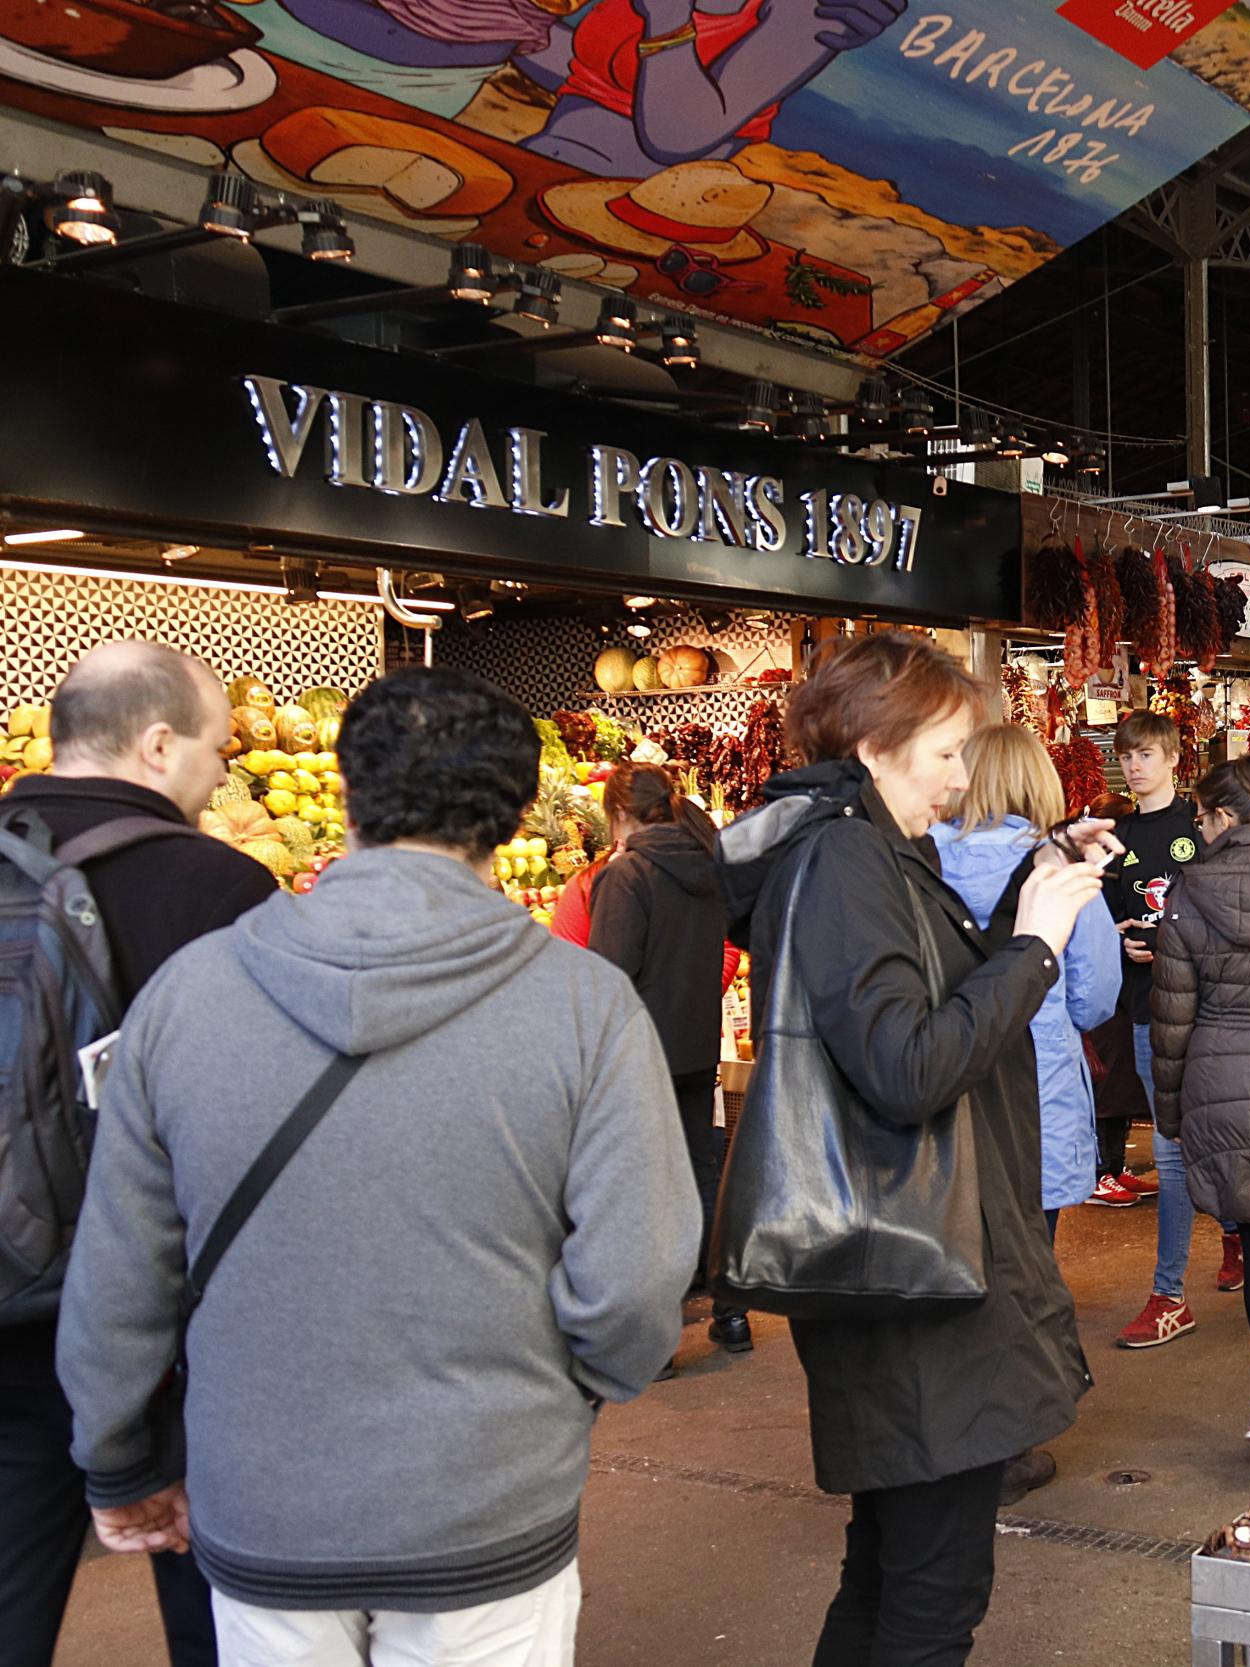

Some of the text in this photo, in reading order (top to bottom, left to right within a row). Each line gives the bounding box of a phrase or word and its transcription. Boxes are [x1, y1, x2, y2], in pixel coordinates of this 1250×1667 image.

[1113, 0, 1154, 33] Damm
[899, 14, 1155, 137] BARCELONA
[1007, 128, 1120, 184] 1876
[243, 374, 922, 573] VIDAL PONS 1897
[1096, 687, 1121, 700] SAFFRON
